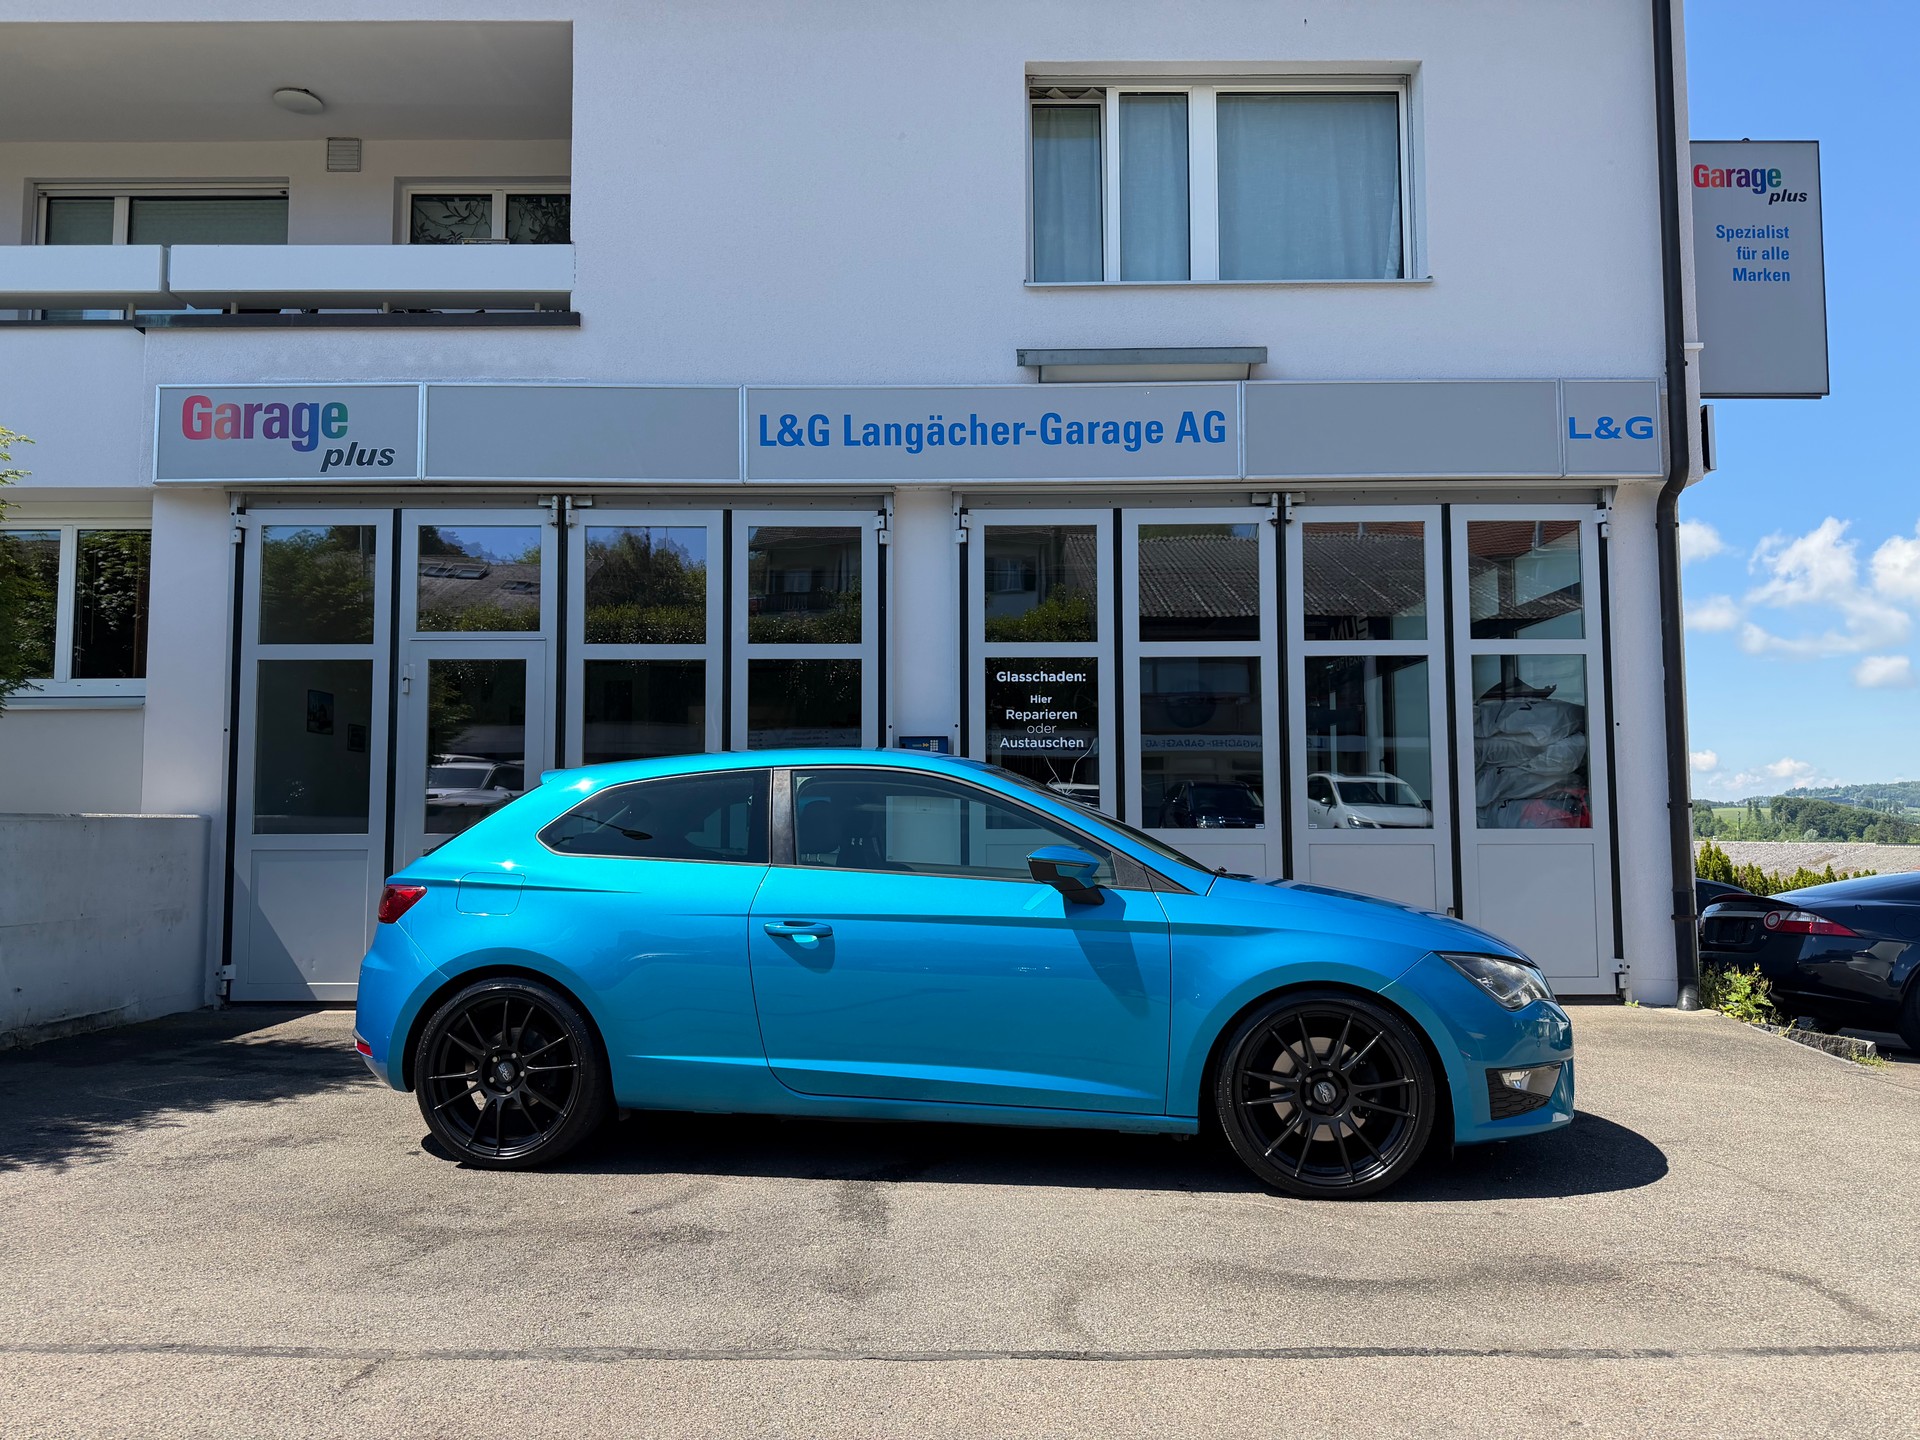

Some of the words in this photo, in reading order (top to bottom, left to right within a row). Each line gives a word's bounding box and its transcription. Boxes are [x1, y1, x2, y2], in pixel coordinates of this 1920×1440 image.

[1693, 164, 1782, 194] Garage
[1768, 189, 1808, 205] plus
[1716, 224, 1790, 242] Spezialist
[1736, 246, 1757, 260] für
[1761, 246, 1790, 260] alle
[1732, 267, 1791, 282] Marken
[181, 394, 349, 452] Garage
[1568, 416, 1654, 440] L&G
[759, 413, 830, 447] L&G
[843, 412, 1164, 454] Langächer-Garage
[1175, 410, 1227, 444] AG
[320, 442, 396, 473] plus
[996, 670, 1087, 683] Glasschaden:
[1030, 694, 1053, 704] Hier
[1005, 709, 1078, 721] Reparieren
[1026, 723, 1057, 734] oder
[999, 737, 1084, 748] Austauschen
